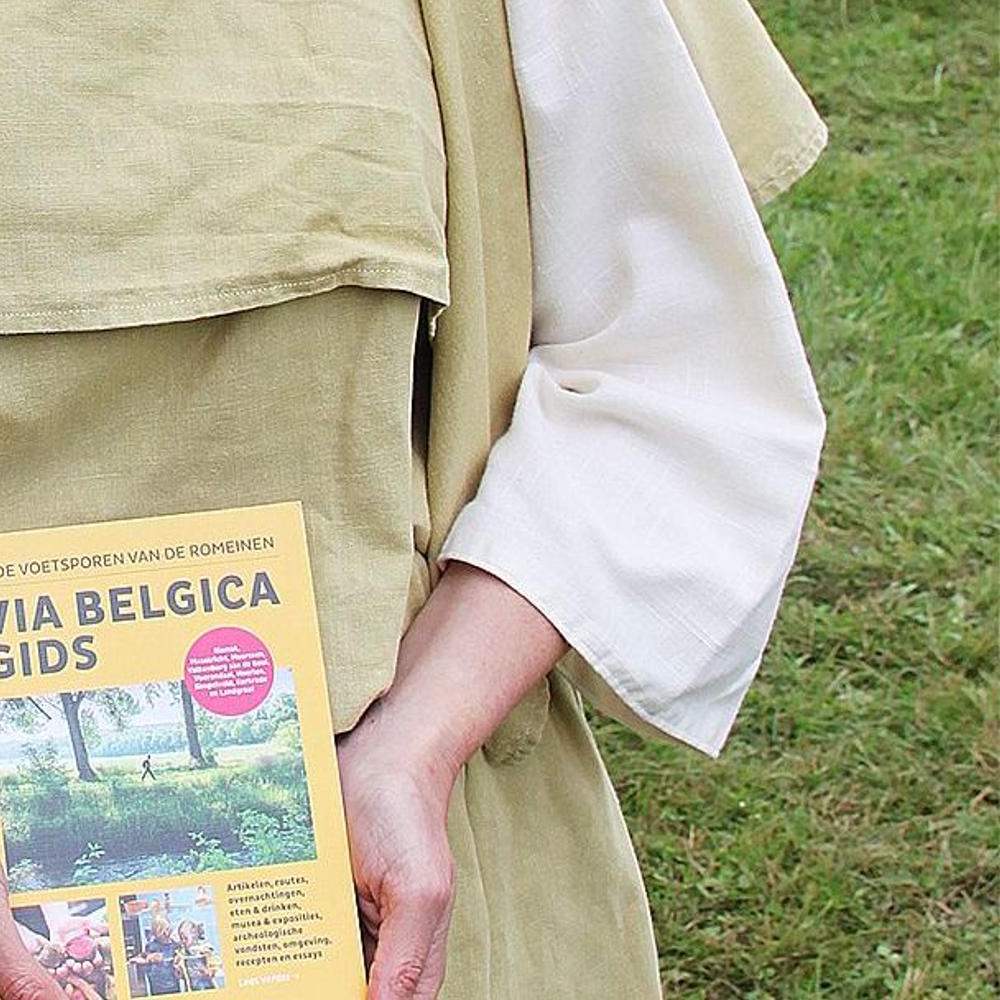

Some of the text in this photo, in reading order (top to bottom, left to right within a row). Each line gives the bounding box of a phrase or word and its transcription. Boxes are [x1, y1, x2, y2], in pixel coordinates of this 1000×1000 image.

[18, 551, 125, 576] VOETSPOREN
[128, 549, 160, 564] VAN
[164, 545, 185, 560] DE
[189, 536, 275, 557] ROMEINEN
[75, 571, 281, 626] BELGICA
[227, 876, 309, 892] Artikelen, routes,
[228, 889, 305, 904] overnachtingen,
[230, 902, 302, 917] eten & drinken,
[231, 920, 261, 929] musea
[272, 912, 323, 925] exposities,
[233, 927, 303, 942] archeologische
[234, 943, 281, 954] vondsten,
[236, 955, 278, 967] recepten
[293, 950, 322, 960] essays
